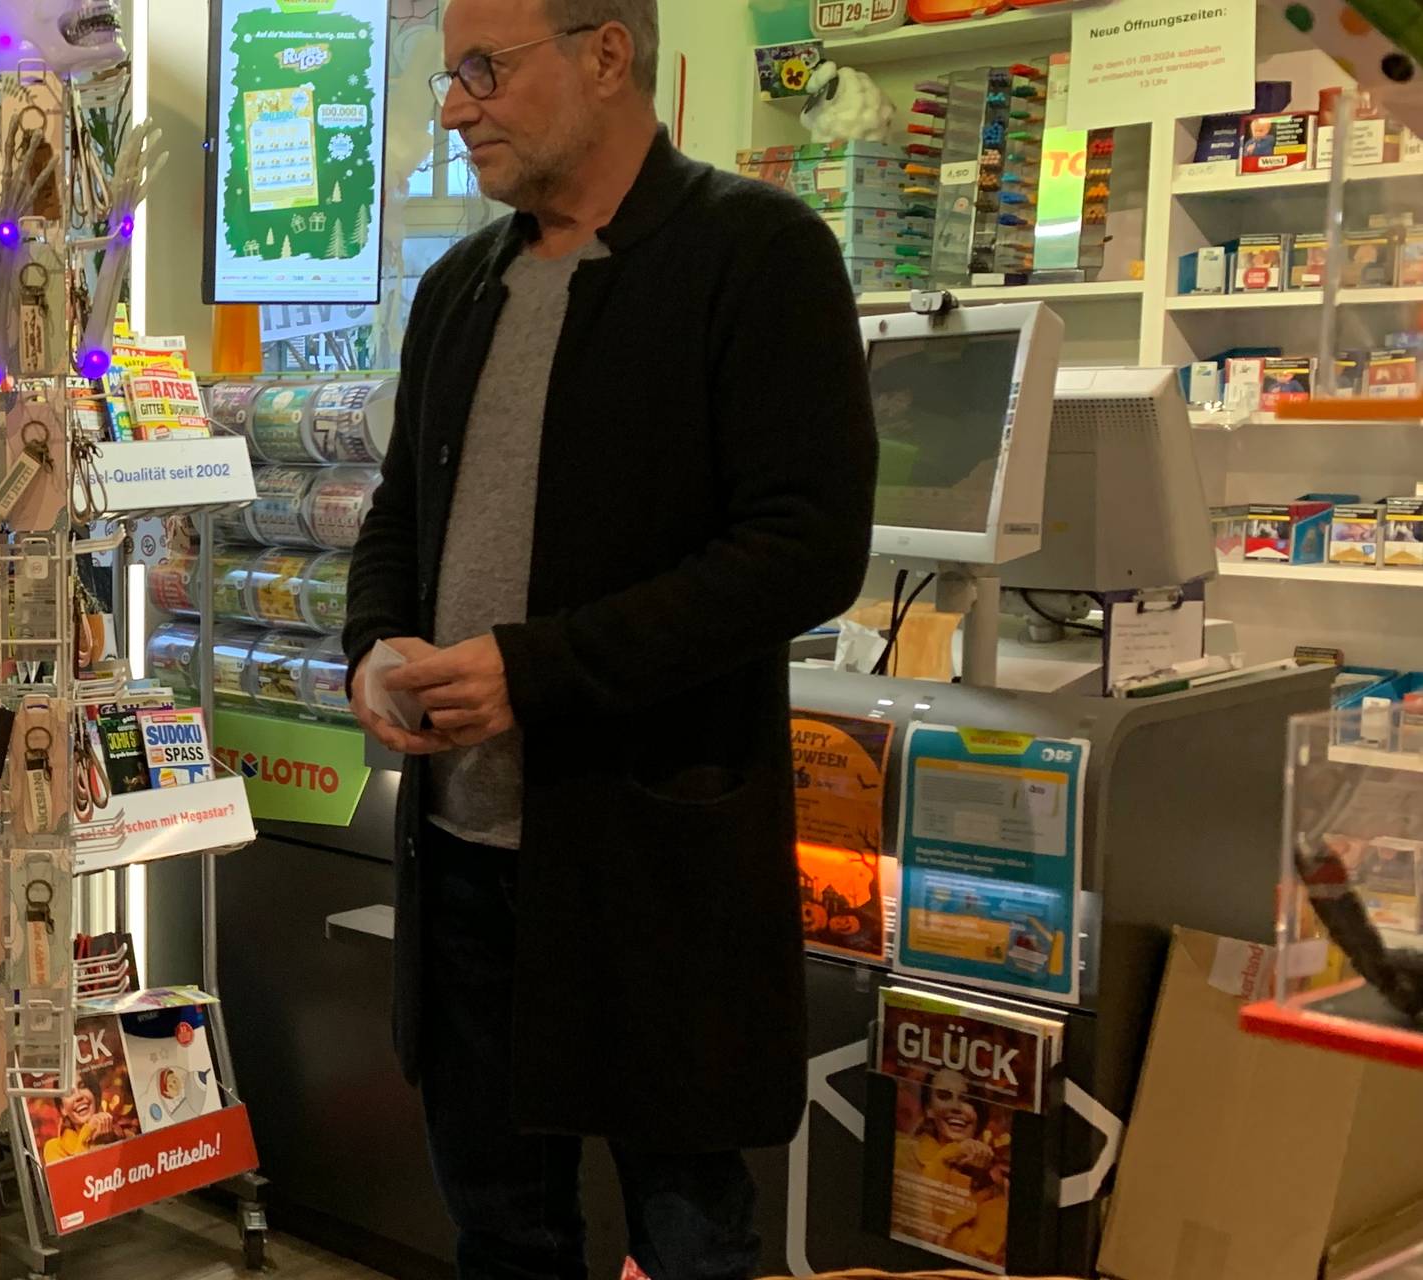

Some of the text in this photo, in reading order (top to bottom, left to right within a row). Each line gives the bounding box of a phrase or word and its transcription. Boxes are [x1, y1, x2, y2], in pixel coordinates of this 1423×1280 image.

[822, 5, 842, 26] BIG
[1090, 8, 1227, 38] Neue Öffnungszeiten:
[170, 466, 193, 481] seit
[197, 463, 230, 478] 2002
[146, 724, 202, 745] SUDOKU
[792, 730, 831, 747] APPY
[165, 747, 204, 762] SPASS
[215, 747, 339, 793] ST LOTTO
[128, 817, 159, 834] schon
[161, 813, 178, 826] mit
[180, 804, 235, 824] Megastar?
[897, 1022, 1020, 1086] GLÜCK
[83, 1132, 221, 1202] Spaß am Rätseln!
